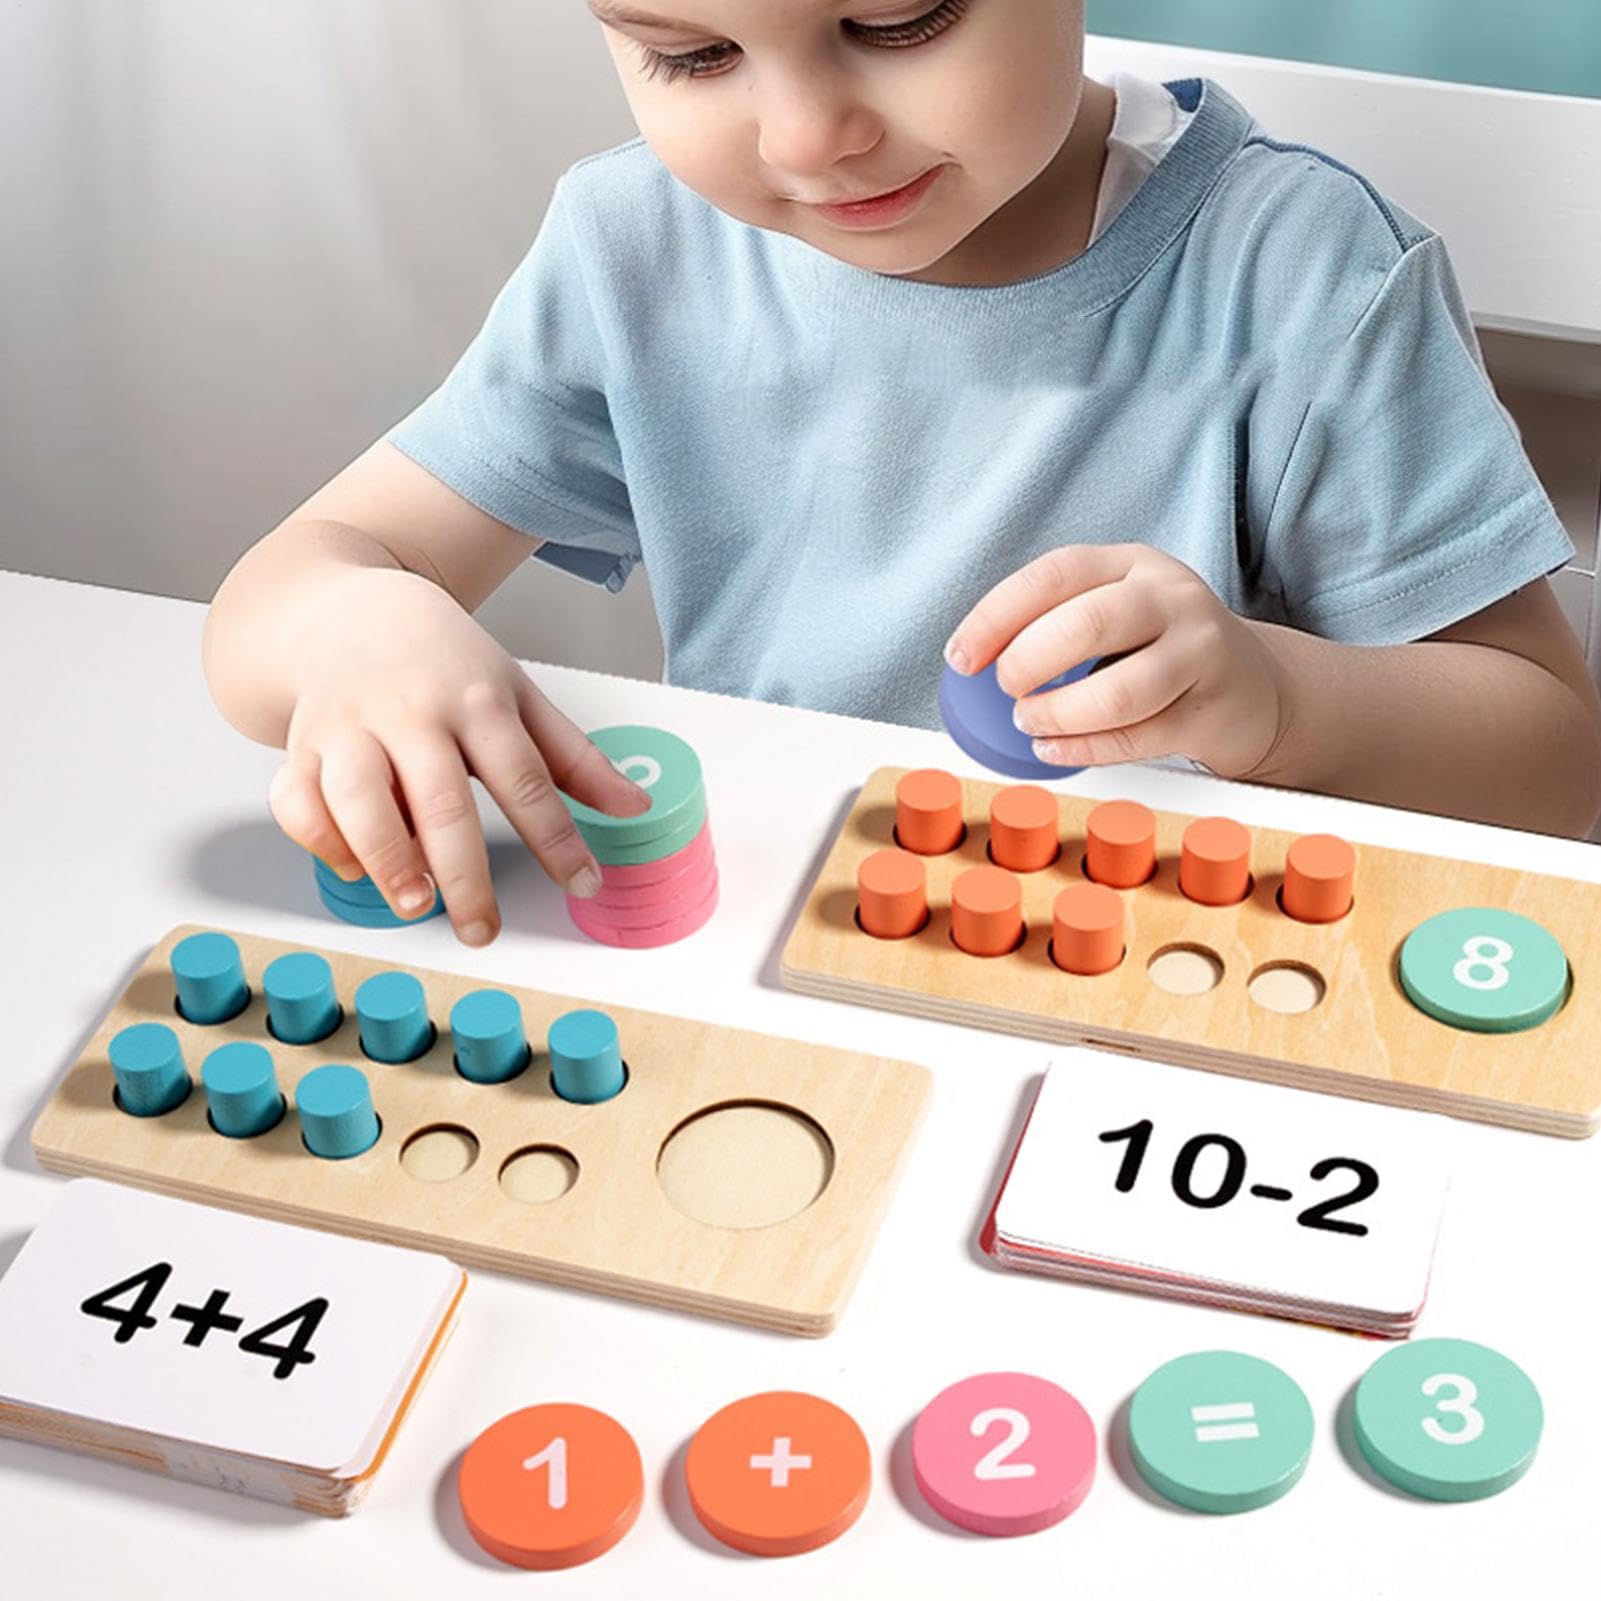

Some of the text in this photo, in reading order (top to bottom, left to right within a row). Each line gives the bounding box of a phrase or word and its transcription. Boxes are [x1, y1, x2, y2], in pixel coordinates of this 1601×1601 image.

[1452, 936, 1514, 991] 8
[1098, 1119, 1380, 1238] 10-2
[80, 1261, 330, 1380] 4+4
[522, 1437, 567, 1509] 1
[971, 1407, 1036, 1480] 2
[1420, 1372, 1486, 1446] 3
